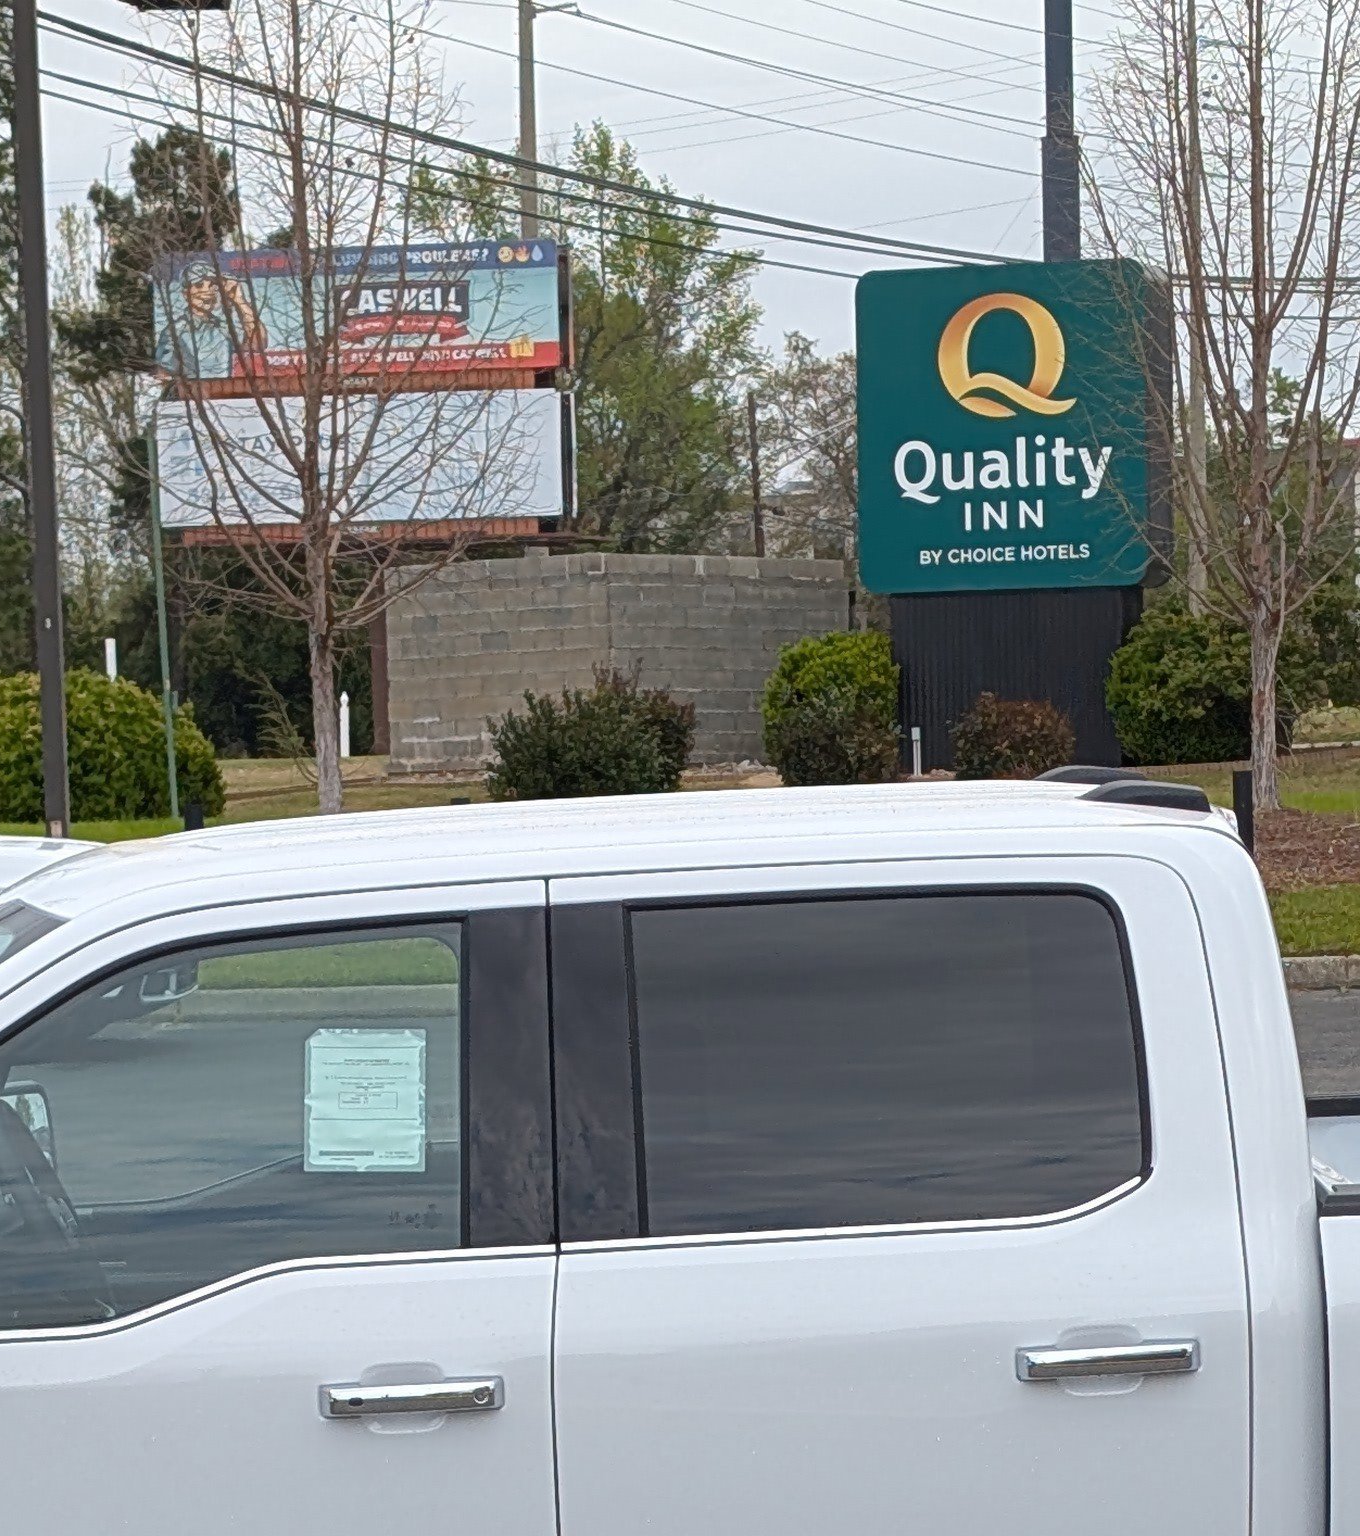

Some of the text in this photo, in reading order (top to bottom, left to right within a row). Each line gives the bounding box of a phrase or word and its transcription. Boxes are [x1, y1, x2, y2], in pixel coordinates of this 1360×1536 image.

[894, 434, 1113, 504] Quality
[964, 499, 1044, 531] INN
[919, 543, 1091, 566] BY CHOICE HOTELS
